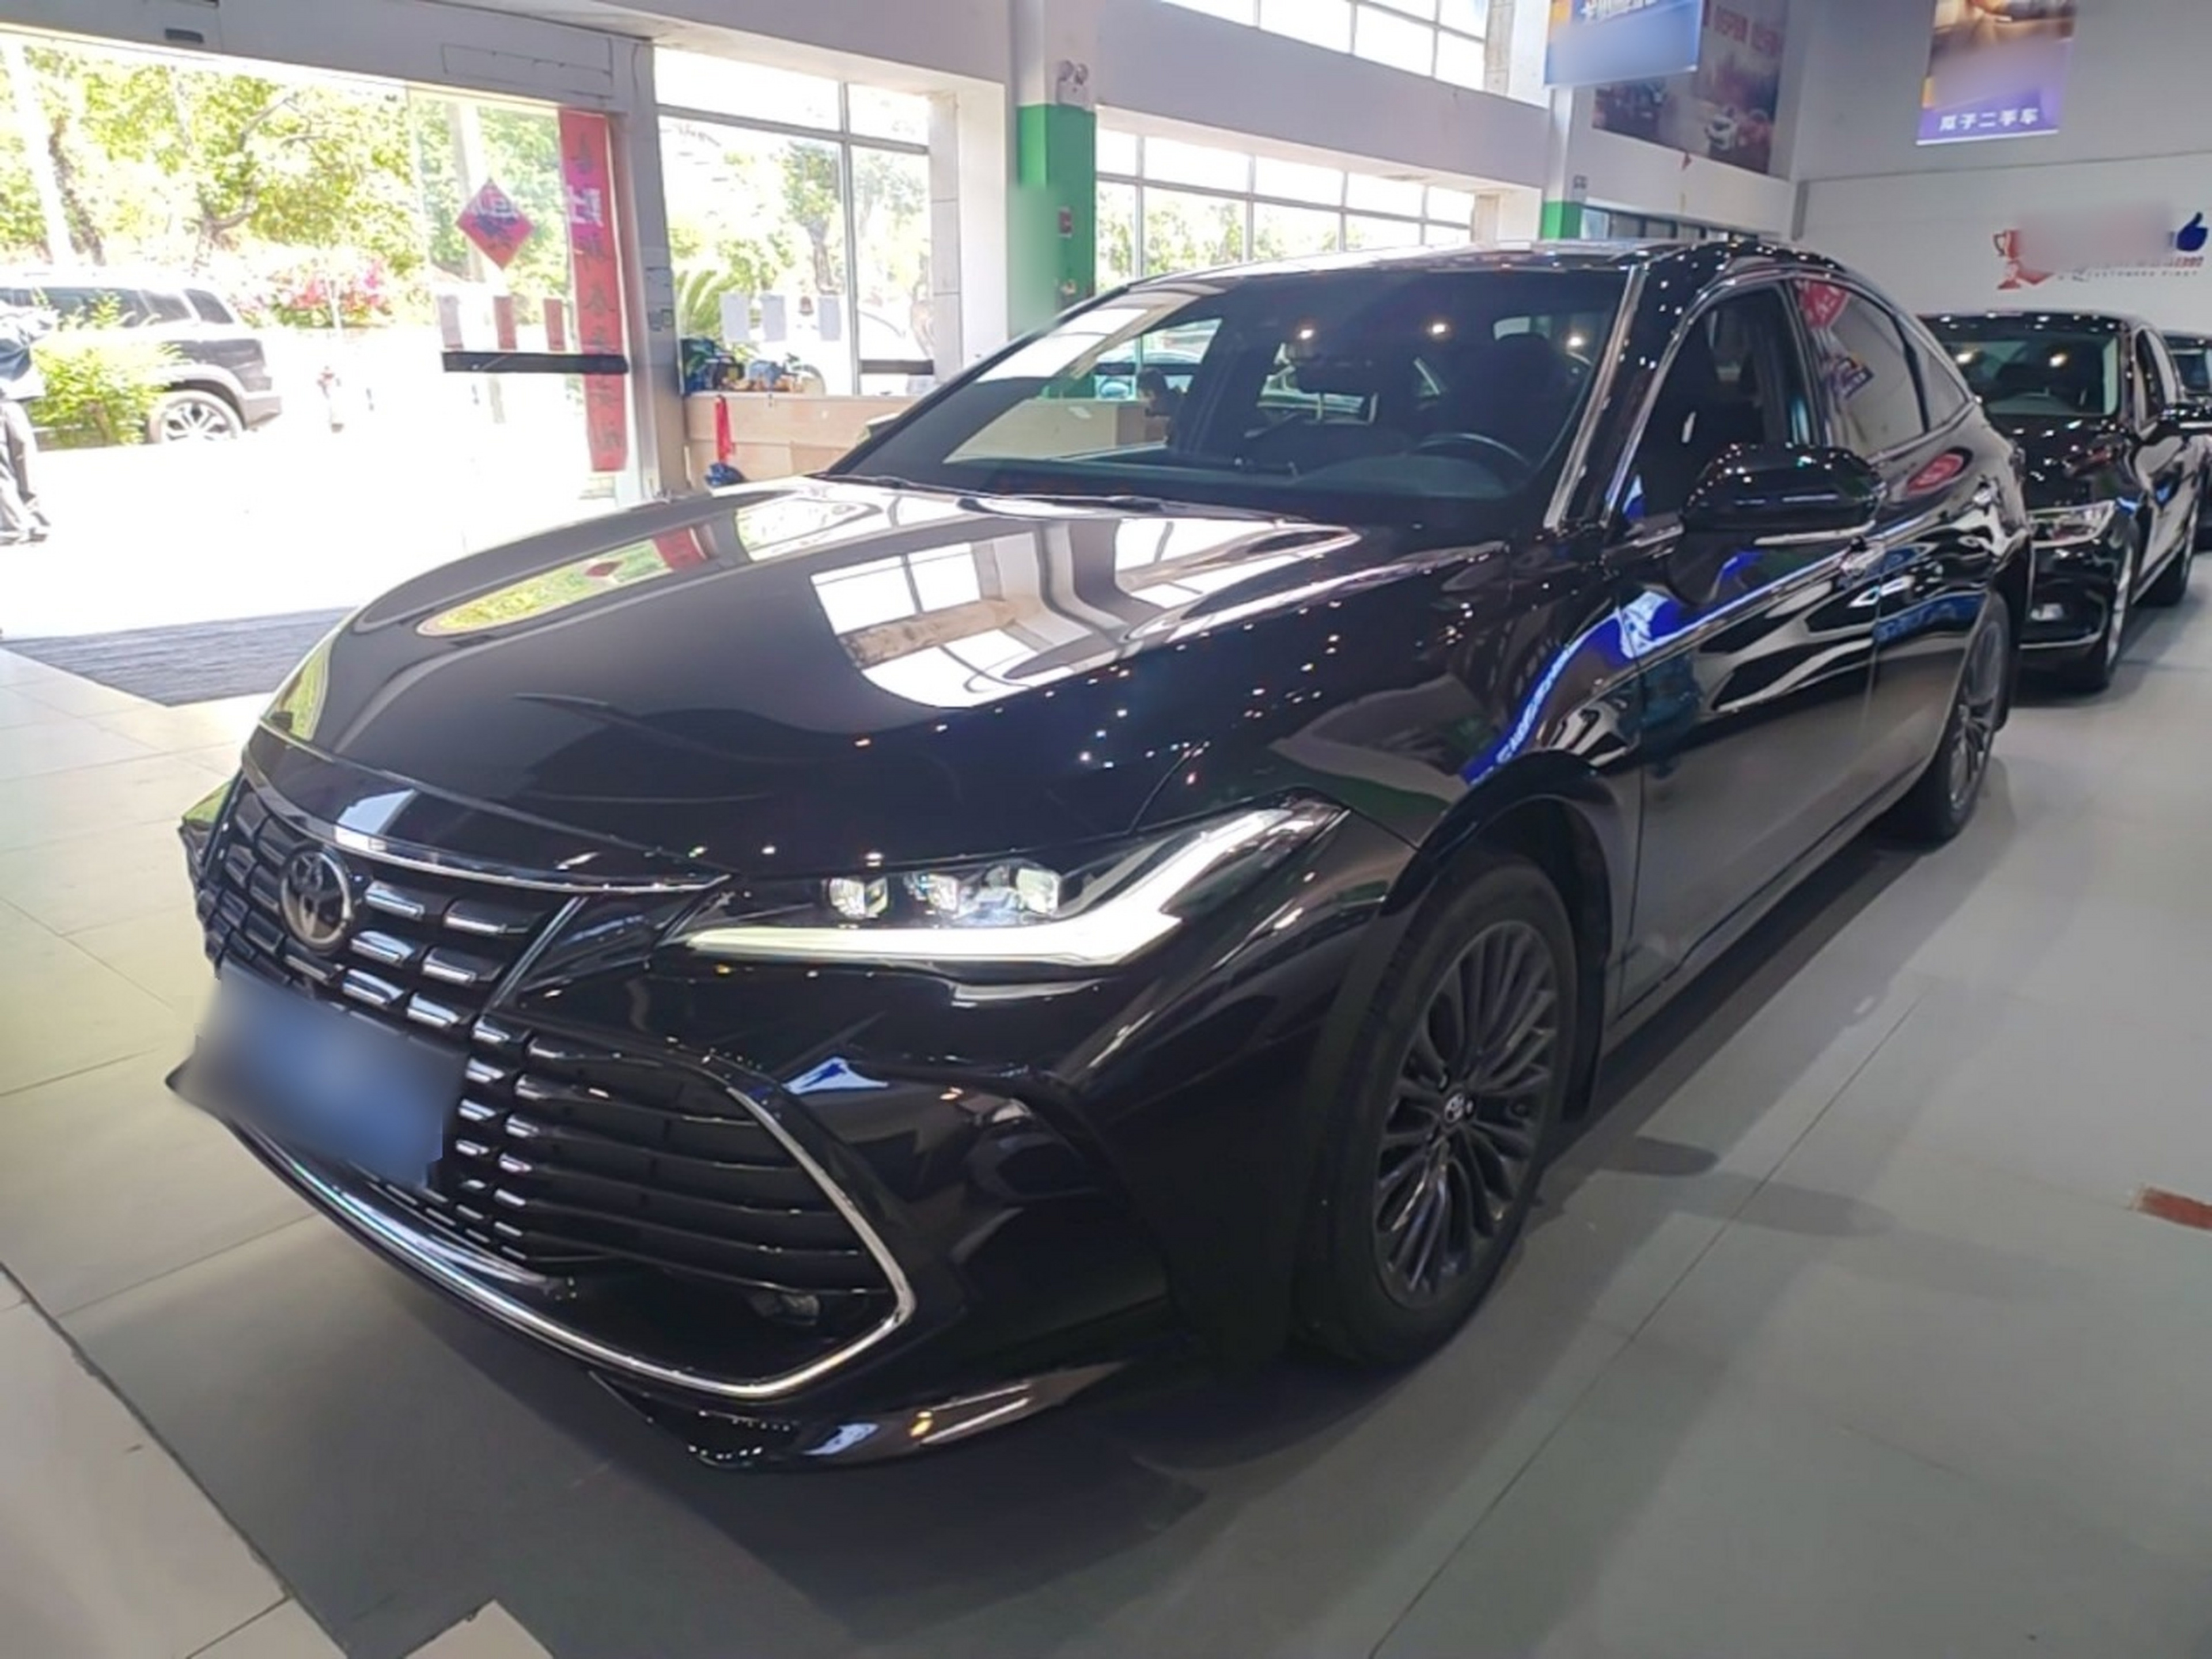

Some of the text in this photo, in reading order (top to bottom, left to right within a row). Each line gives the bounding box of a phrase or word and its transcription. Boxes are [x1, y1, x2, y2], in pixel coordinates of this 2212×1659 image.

[1939, 108, 2039, 131] 瓜子二手车
